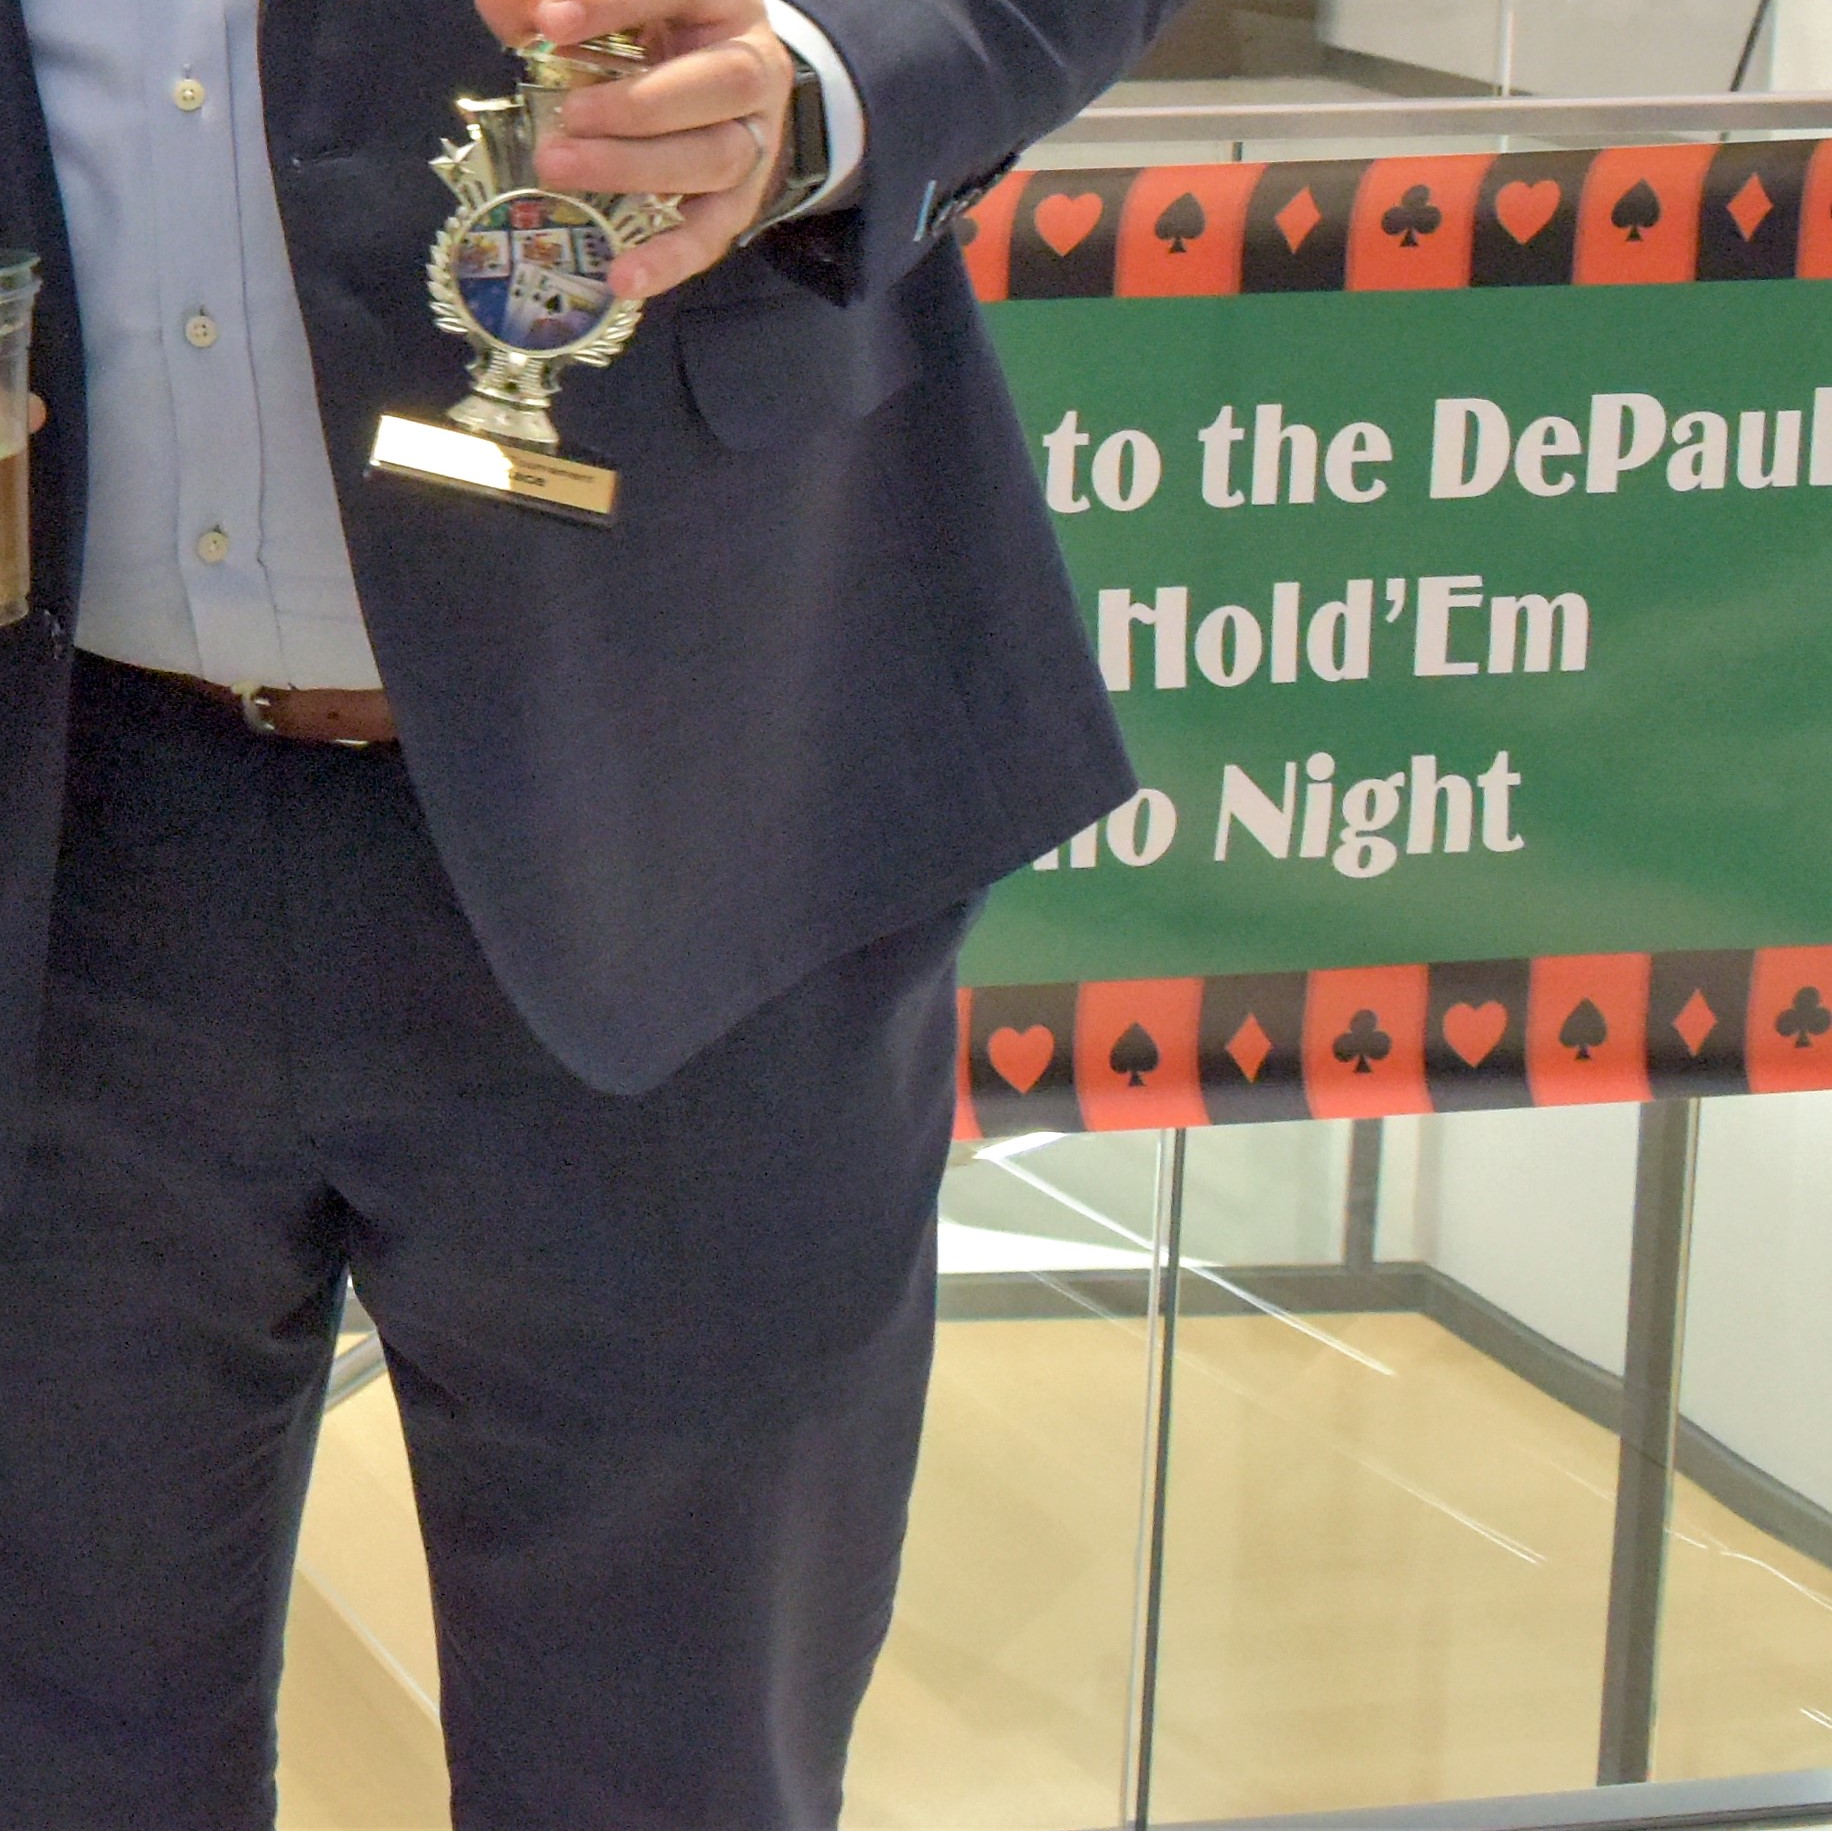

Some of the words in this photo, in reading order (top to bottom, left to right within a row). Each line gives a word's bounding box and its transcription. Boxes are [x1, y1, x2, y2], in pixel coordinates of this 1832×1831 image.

[1042, 410, 1162, 513] to
[1198, 403, 1393, 509] the
[1430, 386, 1832, 500] DePaul
[1097, 574, 1589, 692] Hold'Em
[1214, 751, 1525, 878] Night
